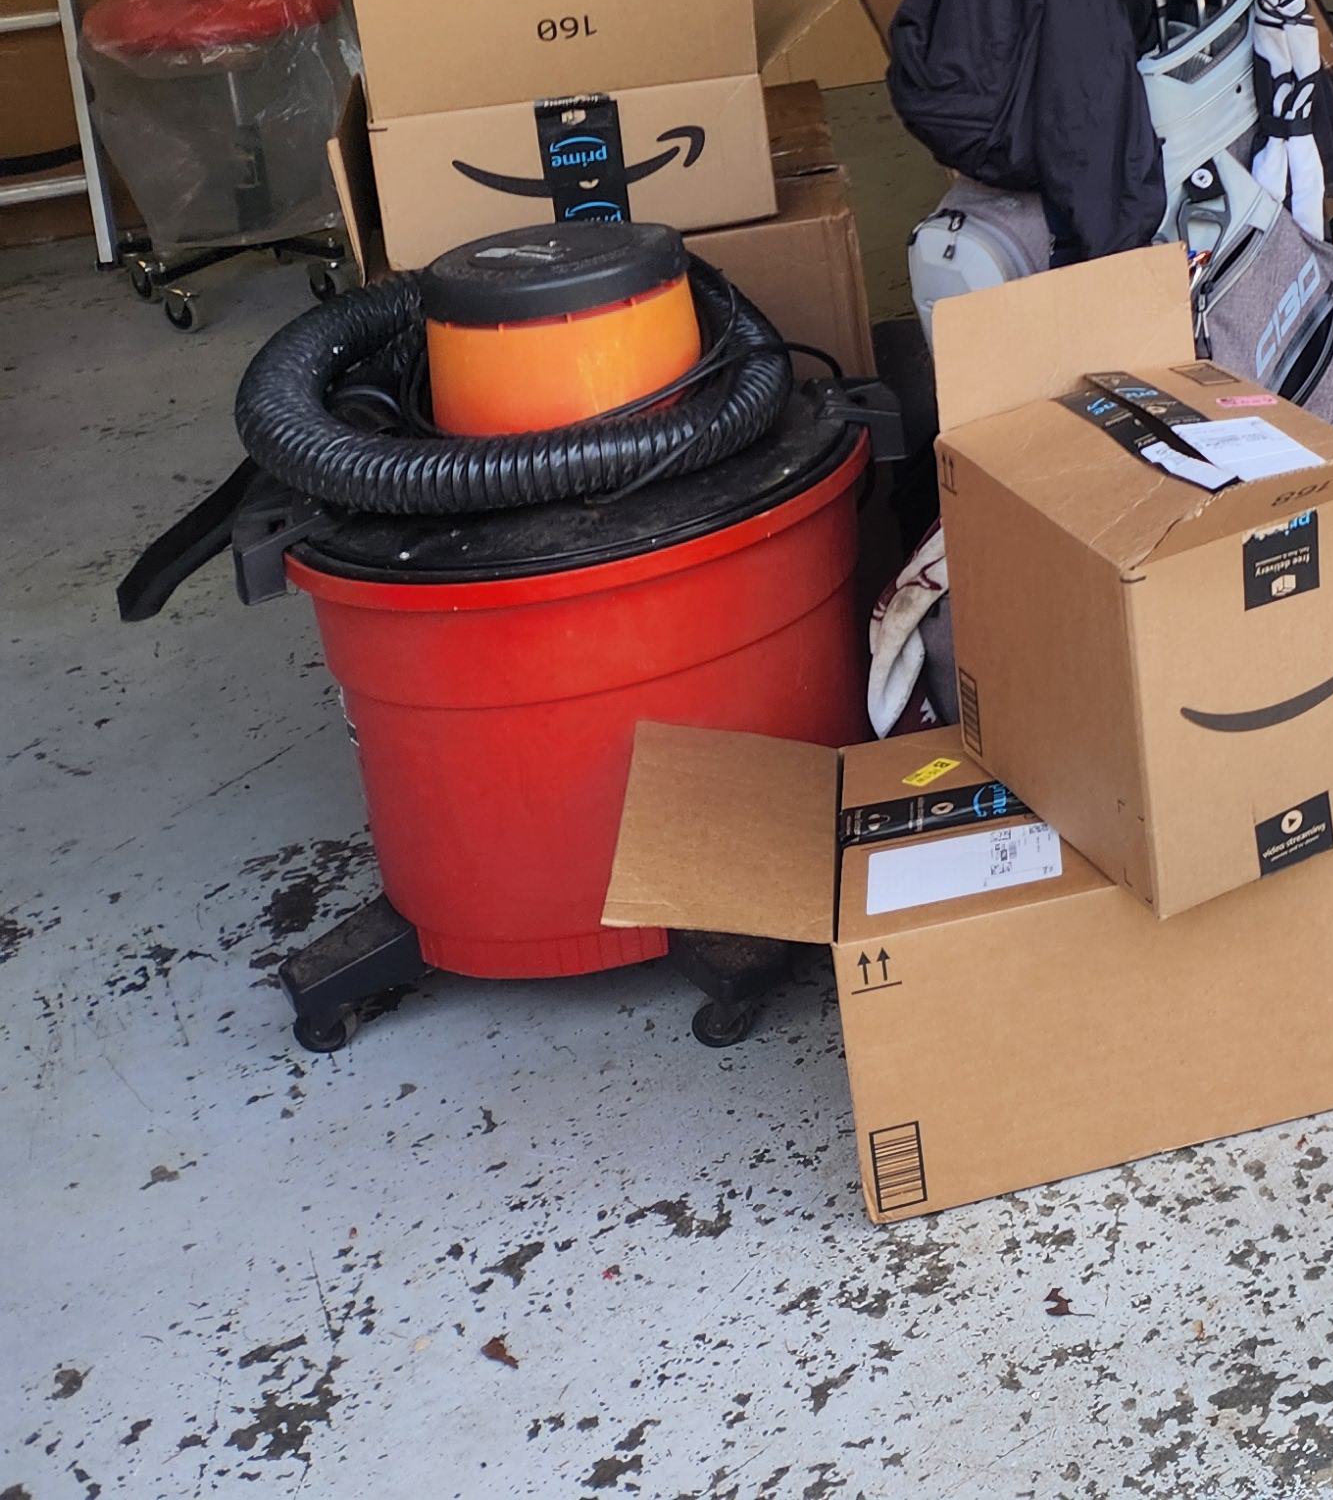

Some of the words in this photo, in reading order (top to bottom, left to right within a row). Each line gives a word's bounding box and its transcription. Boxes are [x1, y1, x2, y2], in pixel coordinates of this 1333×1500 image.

[536, 13, 598, 42] 160
[551, 142, 608, 169] prime
[1255, 559, 1291, 578] delivery
[1292, 553, 1310, 565] free
[1262, 842, 1286, 859] video
[1286, 821, 1327, 849] streaming
